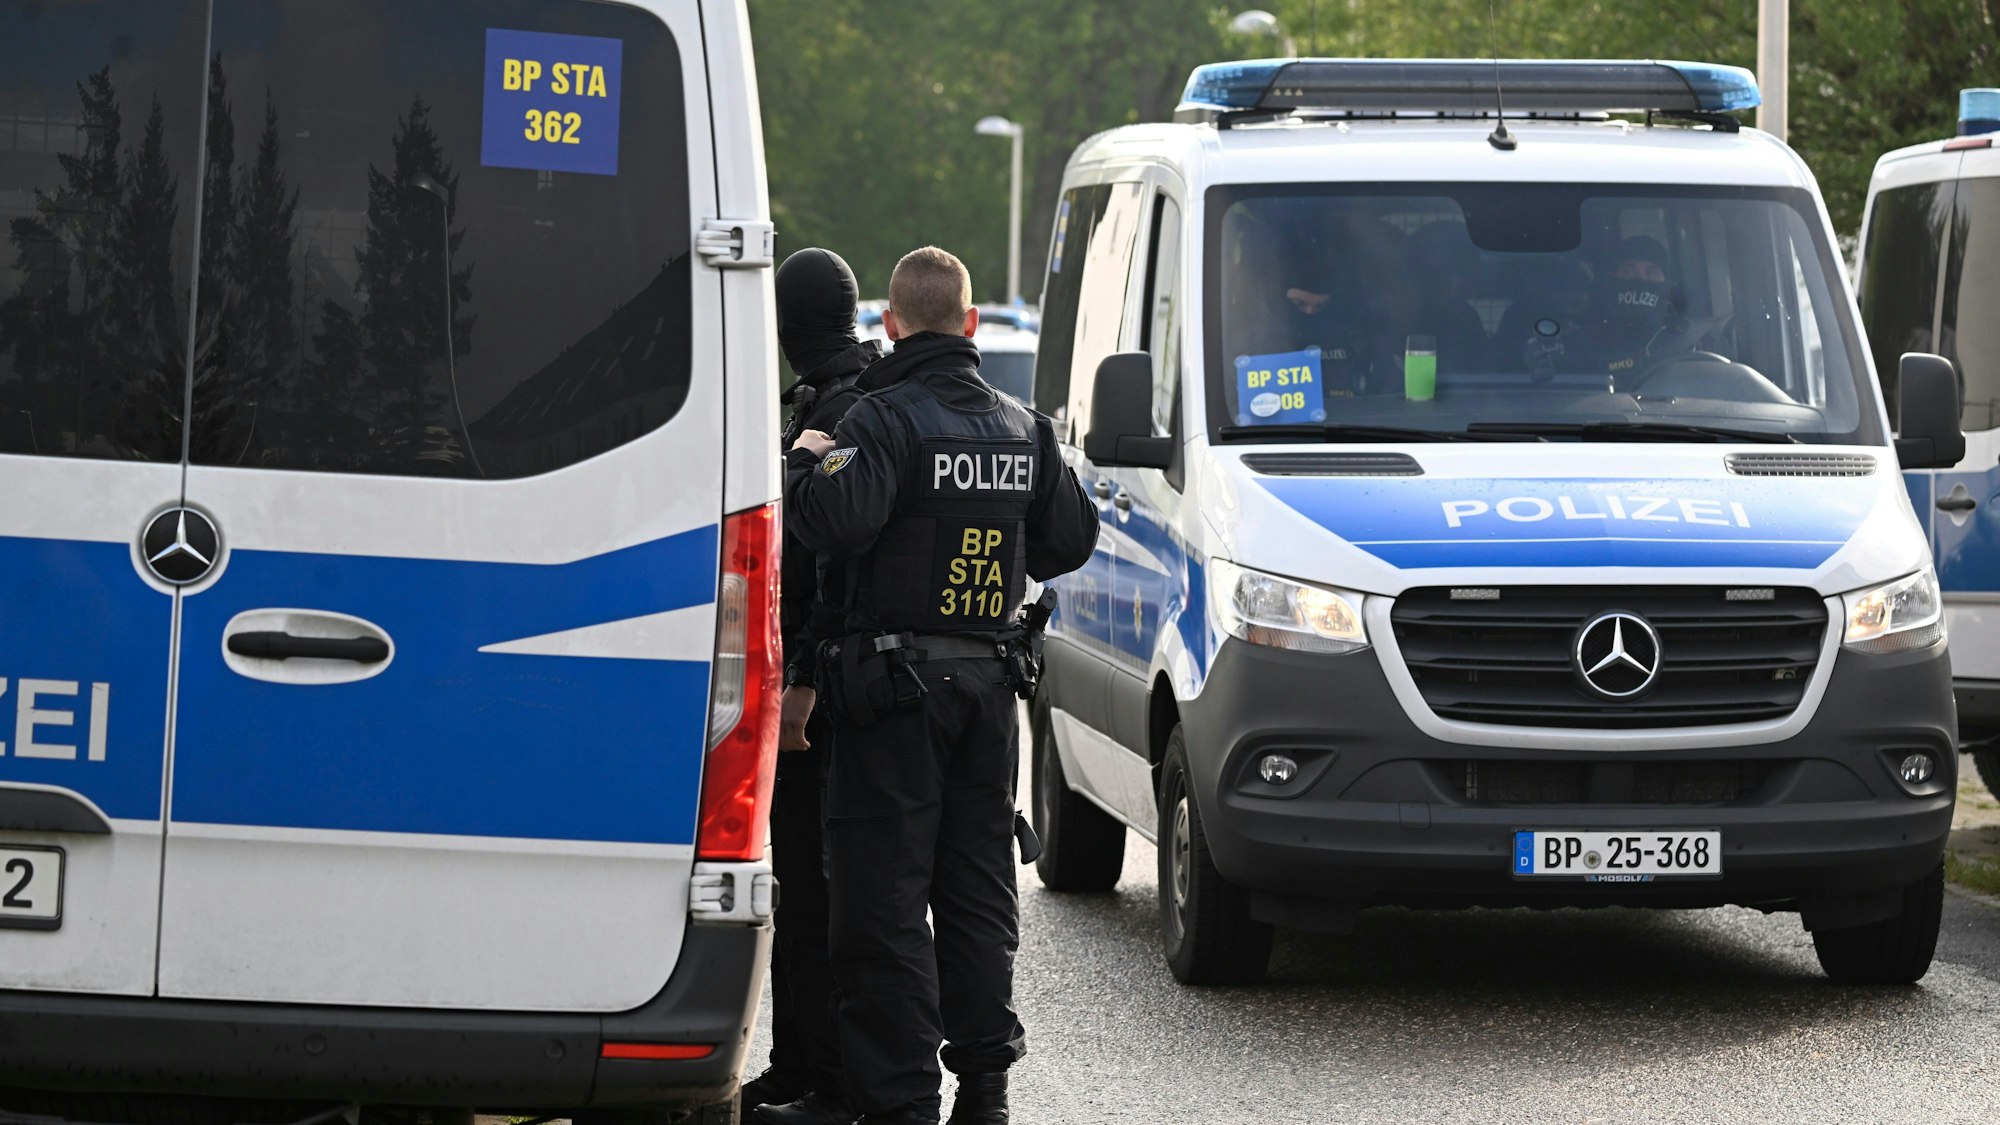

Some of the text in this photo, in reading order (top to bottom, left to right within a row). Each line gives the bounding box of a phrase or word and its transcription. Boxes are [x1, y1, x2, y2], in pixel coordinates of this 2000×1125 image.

[503, 58, 607, 97] BP STA
[524, 109, 582, 144] 362
[1617, 291, 1659, 307] POLIZEI
[1247, 366, 1313, 388] BP STA
[1280, 391, 1305, 411] 08
[933, 453, 1034, 492] POLIZEI
[1442, 495, 1751, 529] POLIZEI
[961, 527, 1003, 556] BP
[948, 558, 1003, 587] STA
[939, 588, 1004, 618] 3110
[0, 677, 110, 762] EI
[1520, 857, 1529, 867] D
[1544, 837, 1710, 868] BP 25-368
[3, 858, 34, 909] 2
